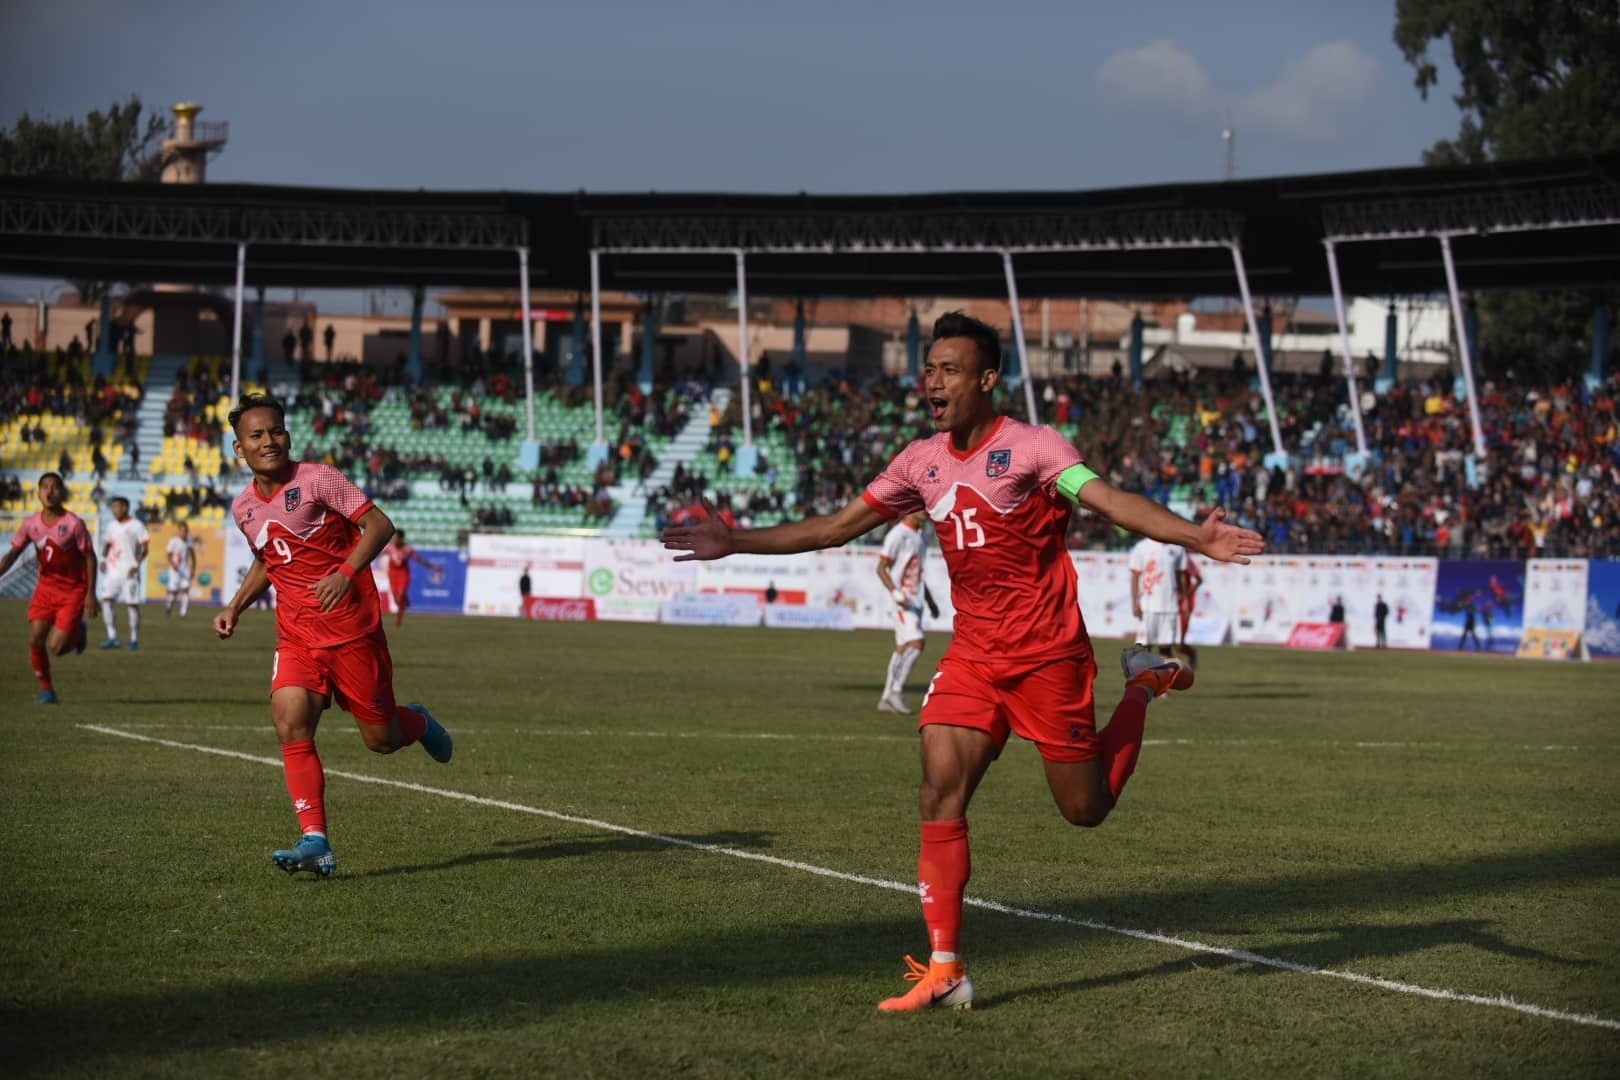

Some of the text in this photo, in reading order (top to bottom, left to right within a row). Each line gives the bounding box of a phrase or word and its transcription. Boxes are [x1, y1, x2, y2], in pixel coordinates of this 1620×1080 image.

[950, 507, 985, 550] 15
[45, 545, 54, 562] 7
[272, 537, 292, 564] 9
